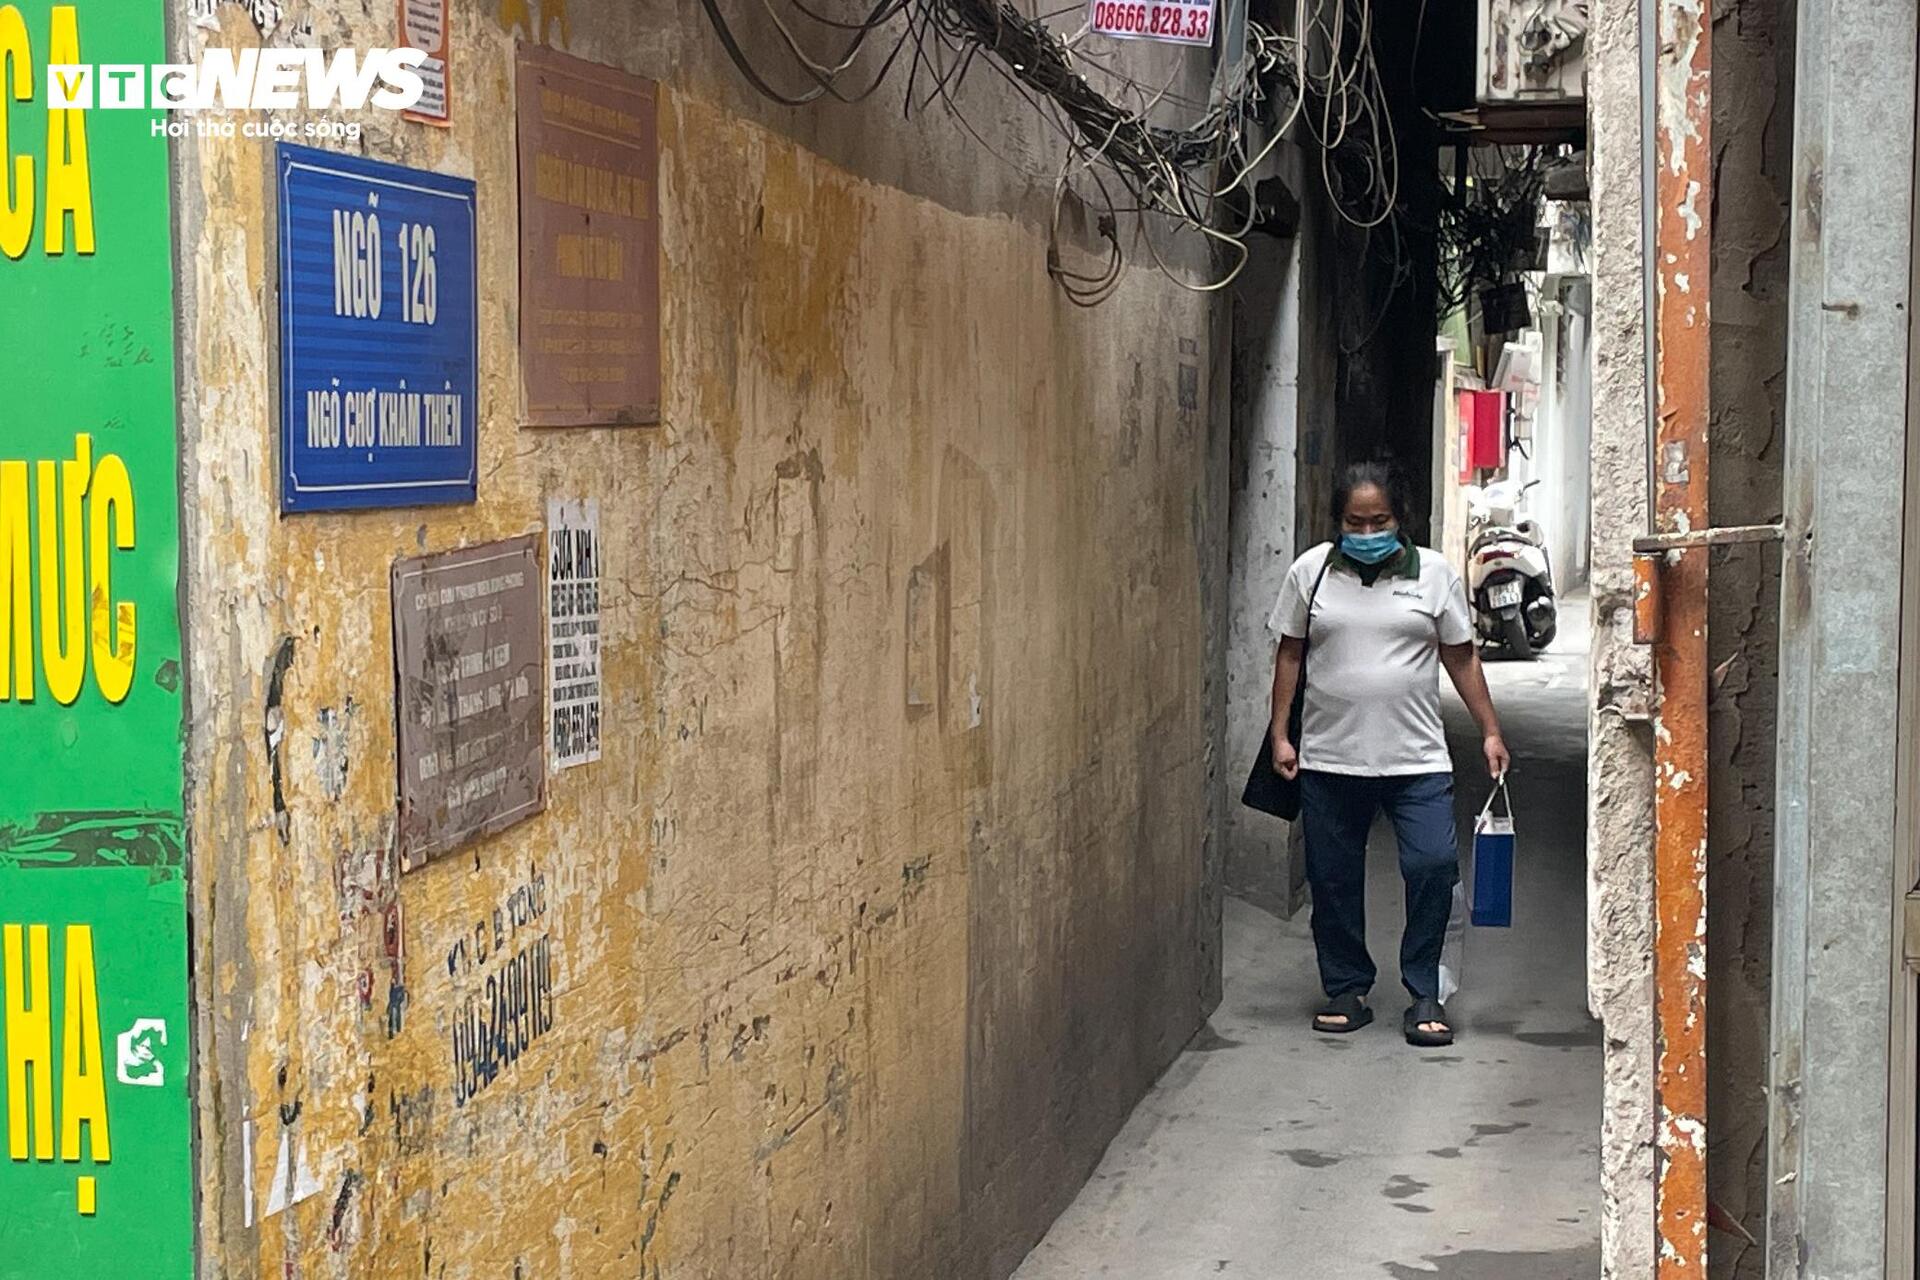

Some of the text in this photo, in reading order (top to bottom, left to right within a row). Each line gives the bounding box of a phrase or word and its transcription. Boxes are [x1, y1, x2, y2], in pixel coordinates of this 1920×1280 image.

[1094, 2, 1209, 38] 08666.828.33
[332, 191, 382, 320] NGÕ
[399, 222, 437, 326] 126
[307, 377, 462, 463] NGÕ CHỢ KHÂM THIÊN
[4, 924, 112, 1215] HẠ
